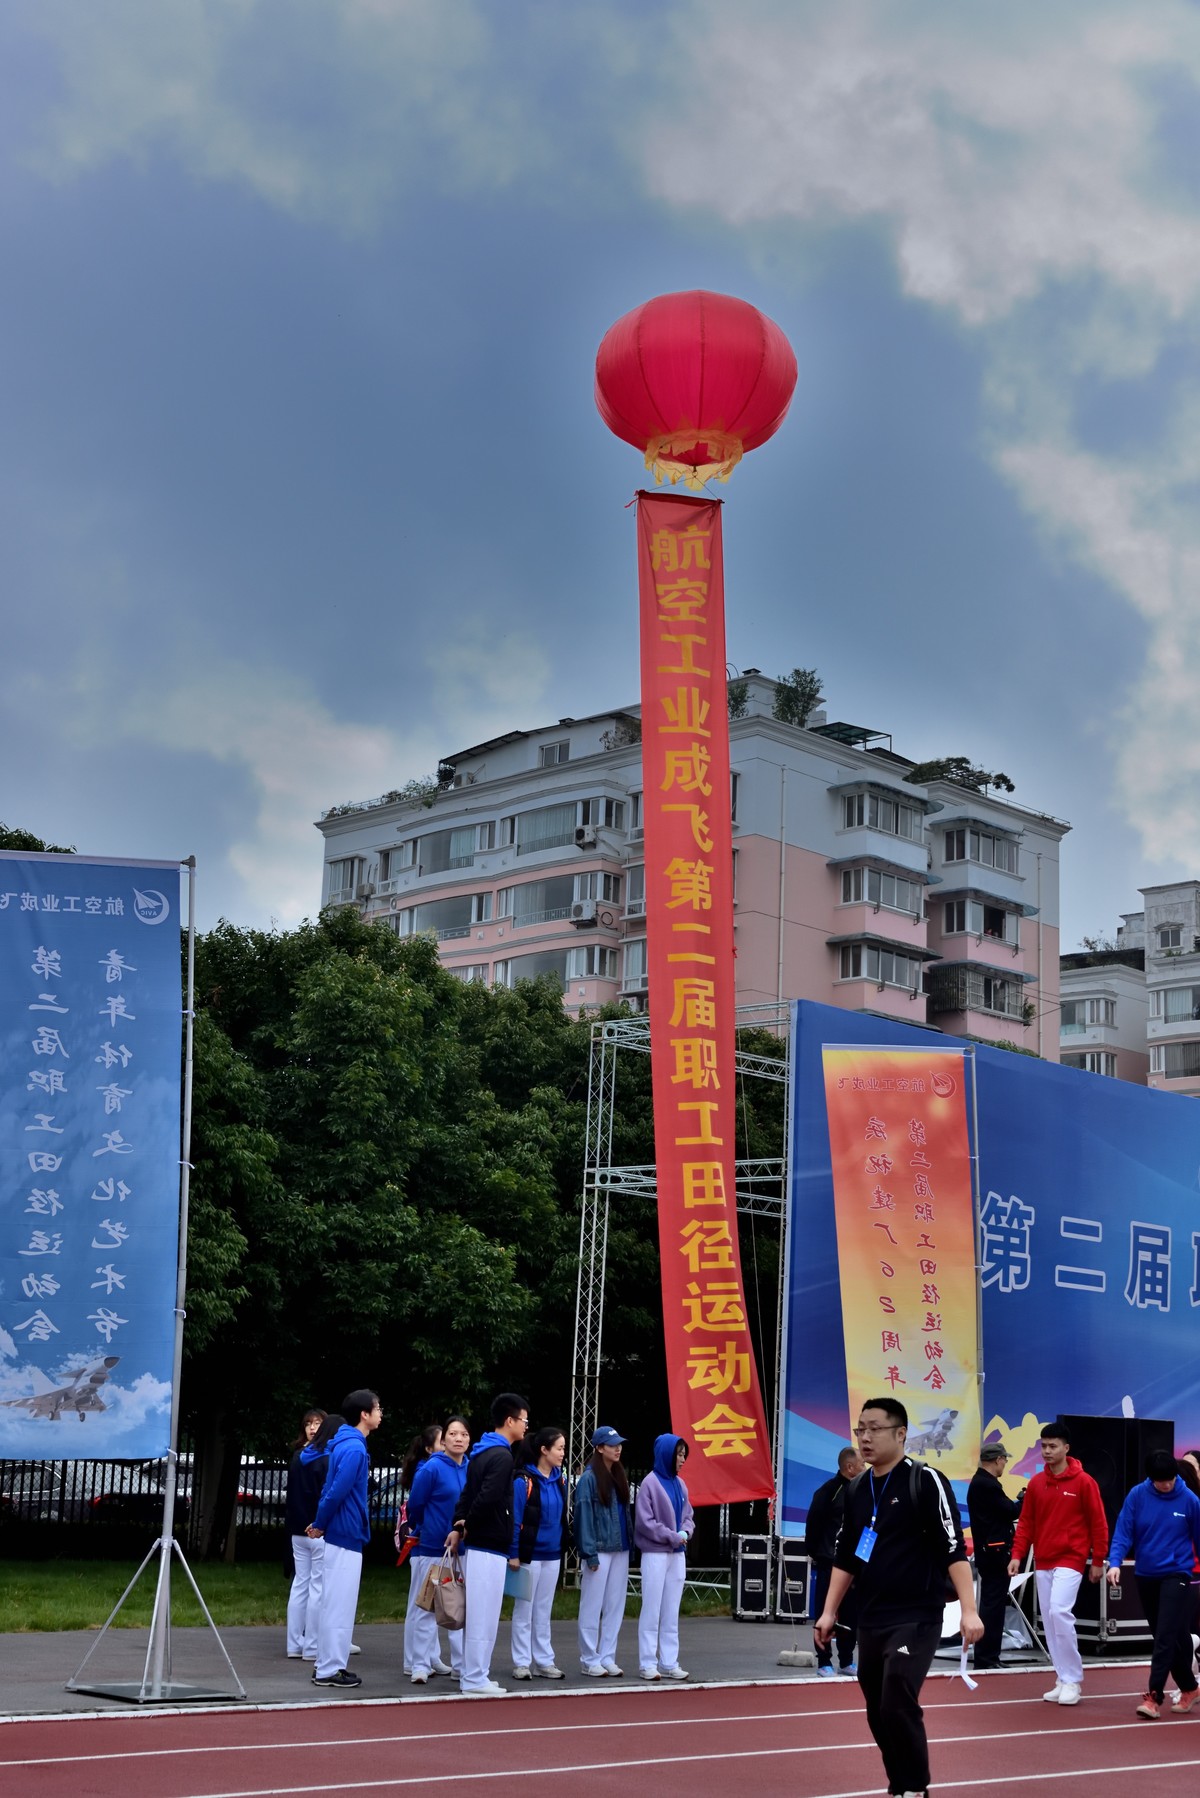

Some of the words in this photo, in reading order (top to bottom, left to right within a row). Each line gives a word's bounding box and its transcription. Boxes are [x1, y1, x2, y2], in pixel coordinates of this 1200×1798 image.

[649, 525, 757, 1458] 航空工业成飞第二届职工田径运动会
[979, 1191, 1200, 1312] 第二届
